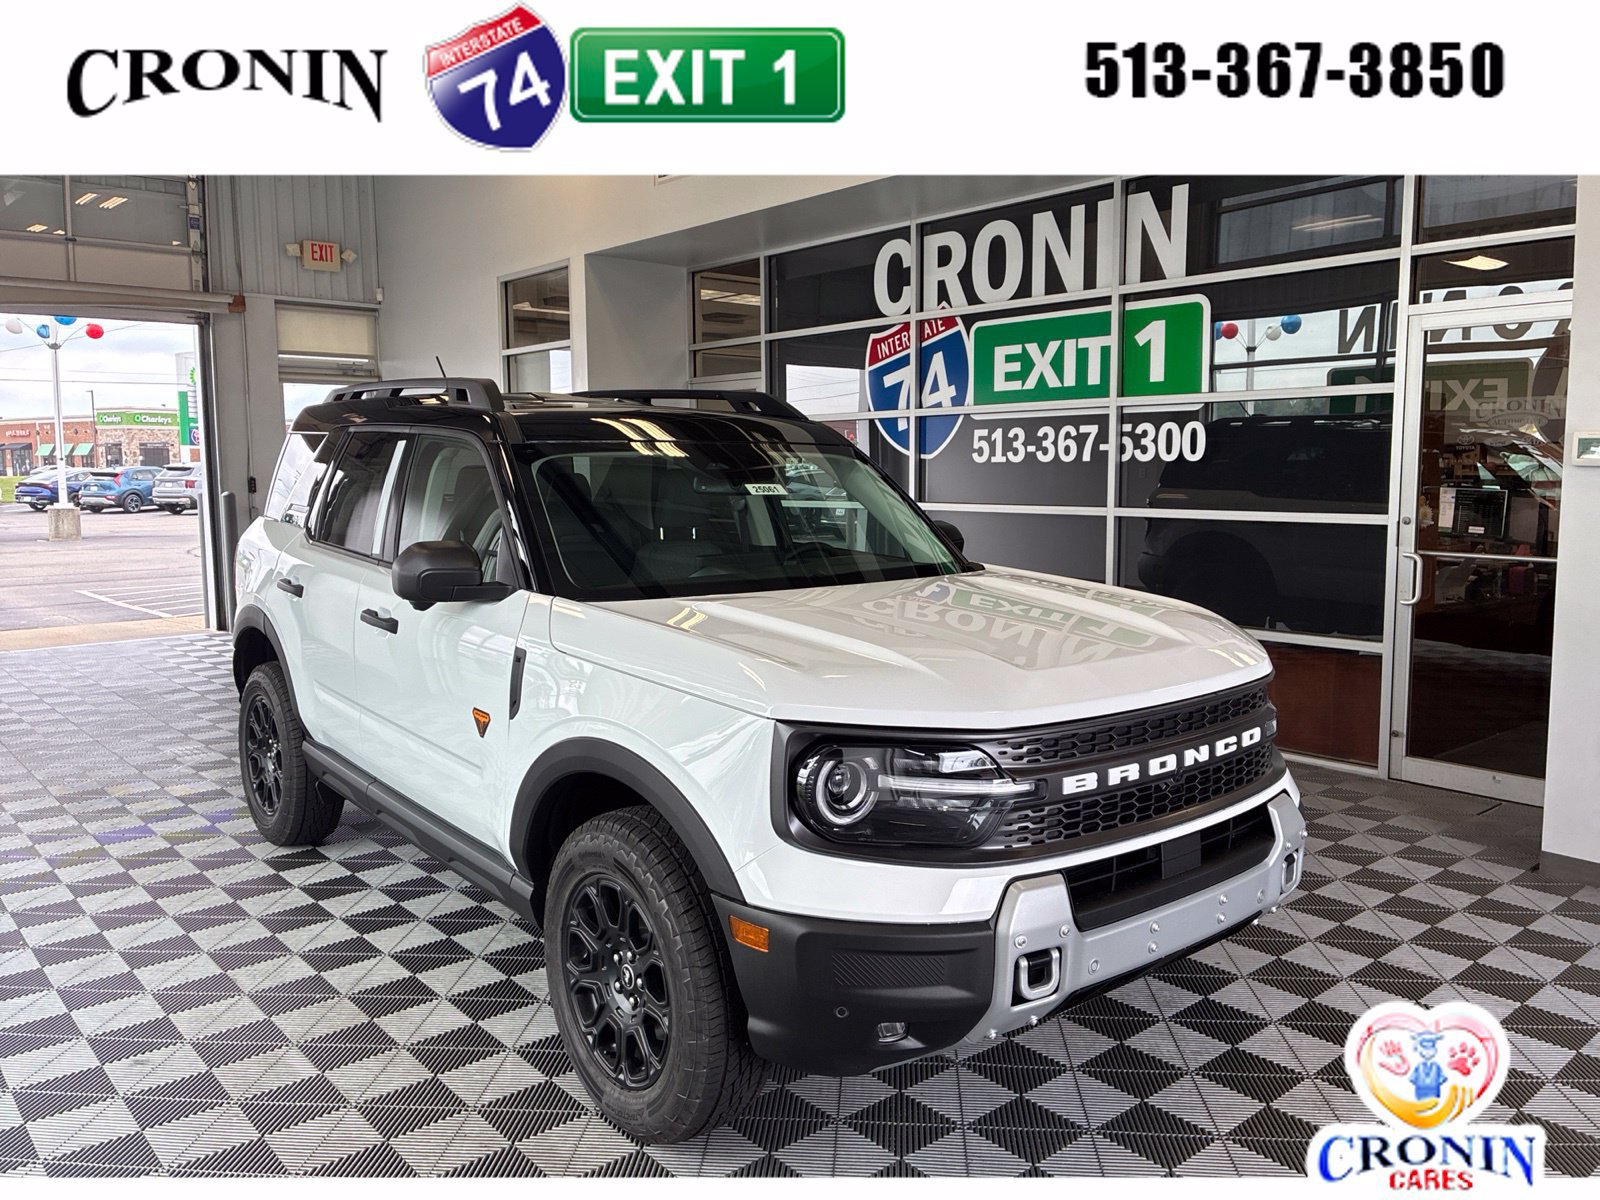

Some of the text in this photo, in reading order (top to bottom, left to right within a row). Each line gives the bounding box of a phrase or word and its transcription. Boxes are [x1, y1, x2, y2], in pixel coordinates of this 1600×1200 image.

[311, 243, 334, 262] EXIT
[873, 183, 1189, 317] CRONIN
[877, 317, 946, 360] INTERATE
[993, 319, 1166, 392] EXIT 1
[883, 350, 957, 432] 74
[971, 420, 1206, 463] 513-367-5300
[752, 485, 780, 494] 25061
[1062, 726, 1262, 796] BRONCO
